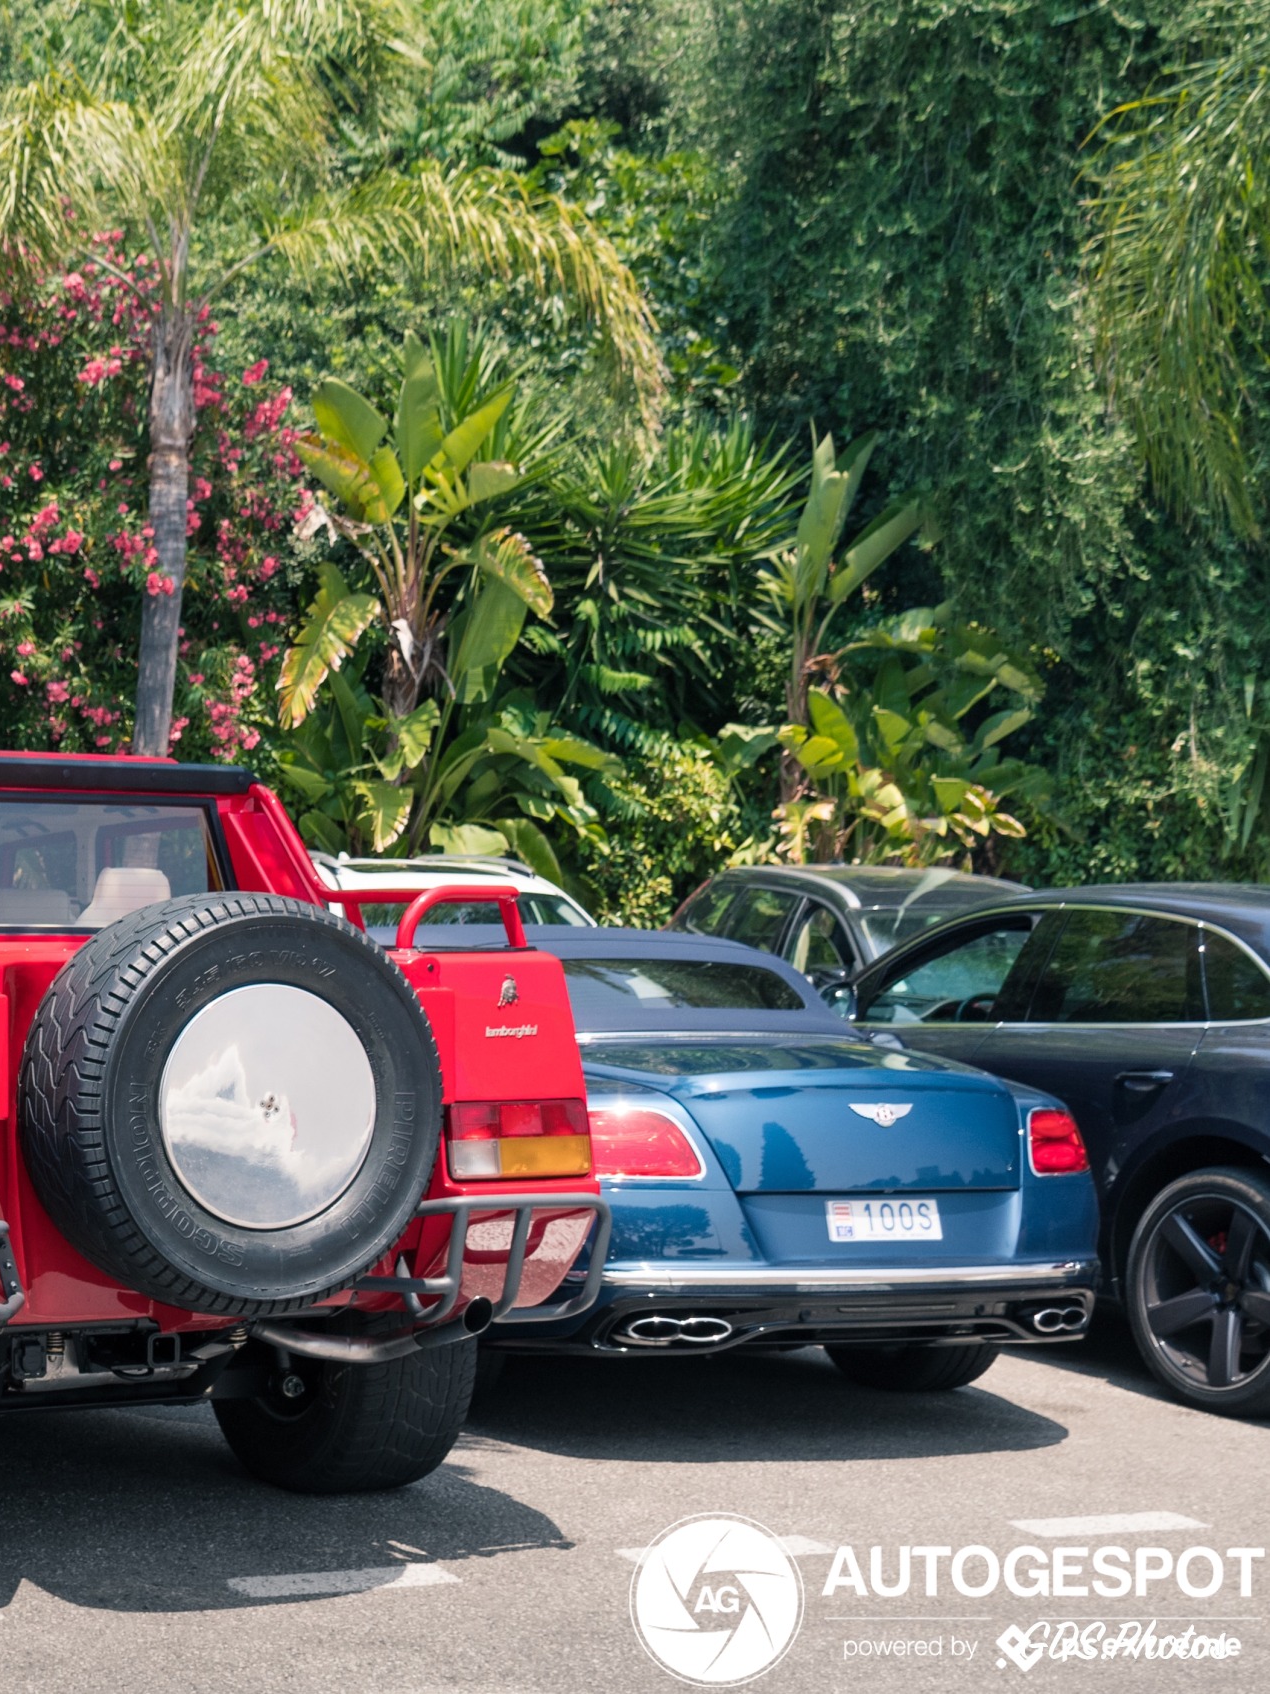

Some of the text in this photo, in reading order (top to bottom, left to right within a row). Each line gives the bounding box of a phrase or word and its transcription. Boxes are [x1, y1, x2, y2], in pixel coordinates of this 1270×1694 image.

[485, 1024, 538, 1039] lamborghini
[130, 1081, 245, 1268] SCORPION
[340, 1091, 416, 1240] PIRELLI
[863, 1203, 932, 1232] 100S
